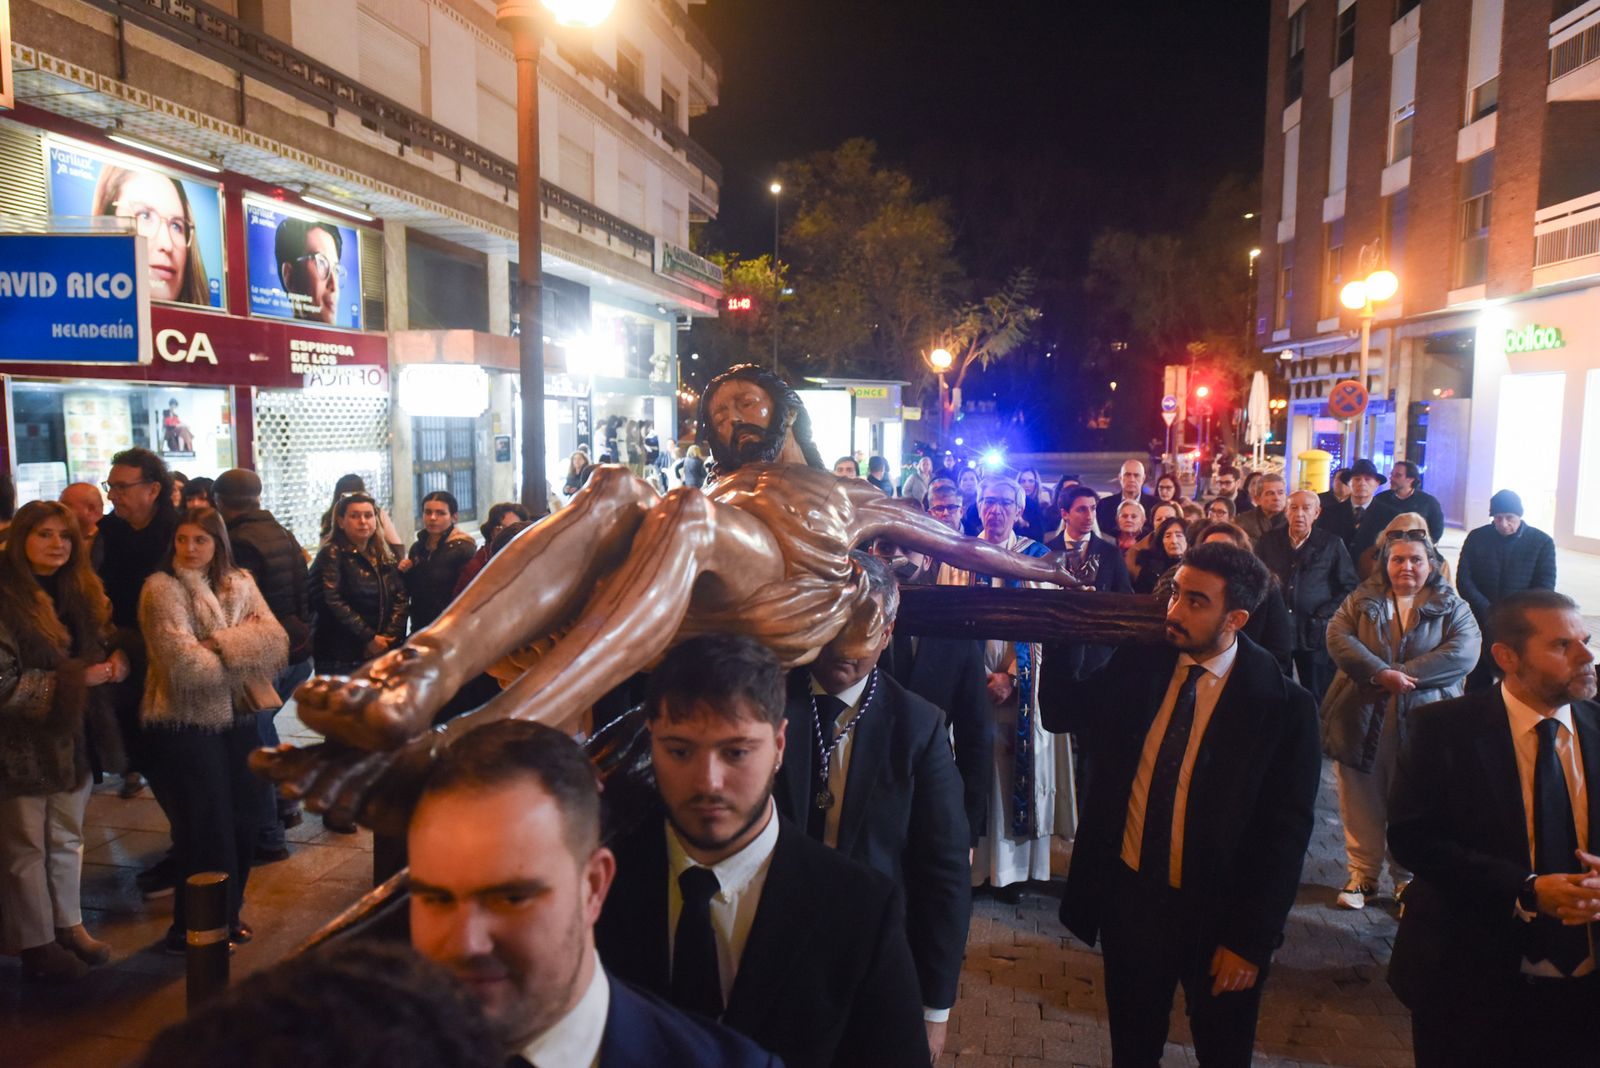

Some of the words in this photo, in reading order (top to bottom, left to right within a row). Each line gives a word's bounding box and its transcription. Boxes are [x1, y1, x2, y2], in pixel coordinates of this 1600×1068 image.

[67, 272, 133, 299] RICO
[52, 318, 133, 339] HELADERÍA
[156, 329, 218, 365] CA
[290, 340, 355, 356] ESPINOSA
[291, 352, 309, 363] DE
[312, 353, 337, 365] LOS
[856, 388, 883, 396] ONCE
